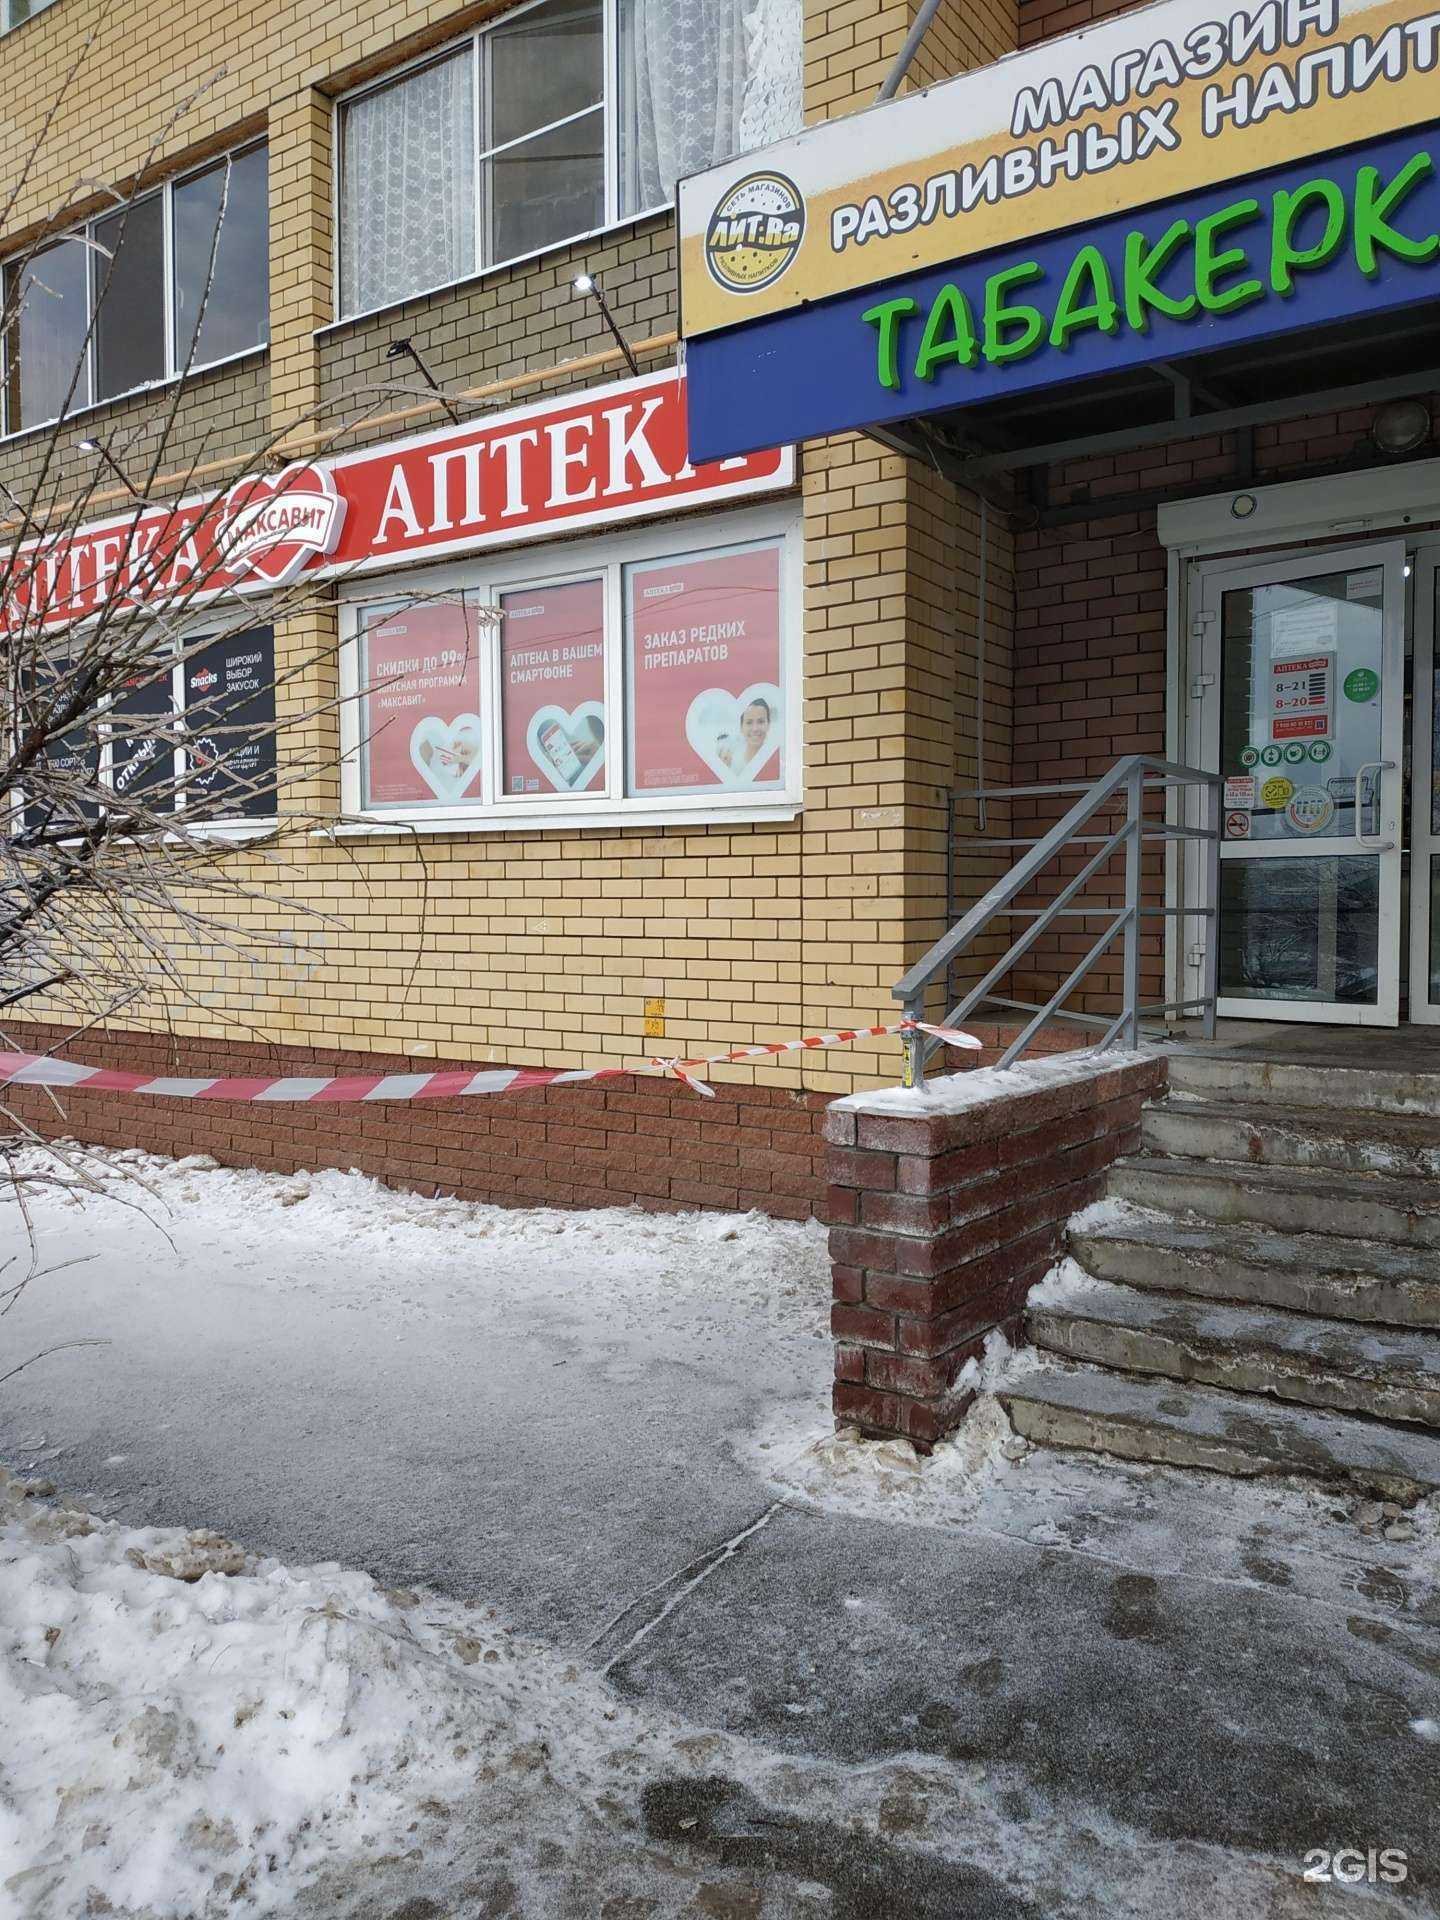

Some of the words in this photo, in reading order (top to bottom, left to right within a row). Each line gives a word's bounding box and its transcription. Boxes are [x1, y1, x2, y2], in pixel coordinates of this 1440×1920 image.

[1010, 0, 1337, 138] МАГАЗИН
[832, 98, 1180, 250] РАЗЛИВНЫХ
[1202, 12, 1440, 138] НАПИТ
[372, 396, 748, 545] АПТЕК
[644, 629, 687, 650] ЗАКАЗ
[690, 619, 746, 644] РЕДКИХ
[226, 651, 263, 668] ШИРОКИЙ
[376, 658, 420, 677] СКИДКИ
[422, 655, 438, 674] ДО
[510, 650, 550, 668] АПТЕКА
[552, 648, 561, 662] В
[563, 642, 603, 661] ВАШЕМ
[643, 643, 729, 670] ПРЕПАРАТОВ
[191, 673, 218, 689] Snacks
[226, 667, 253, 681] ВЫБОР
[226, 679, 260, 693] ЗАКУСОК
[510, 663, 573, 685] СМАРТФОНЕ
